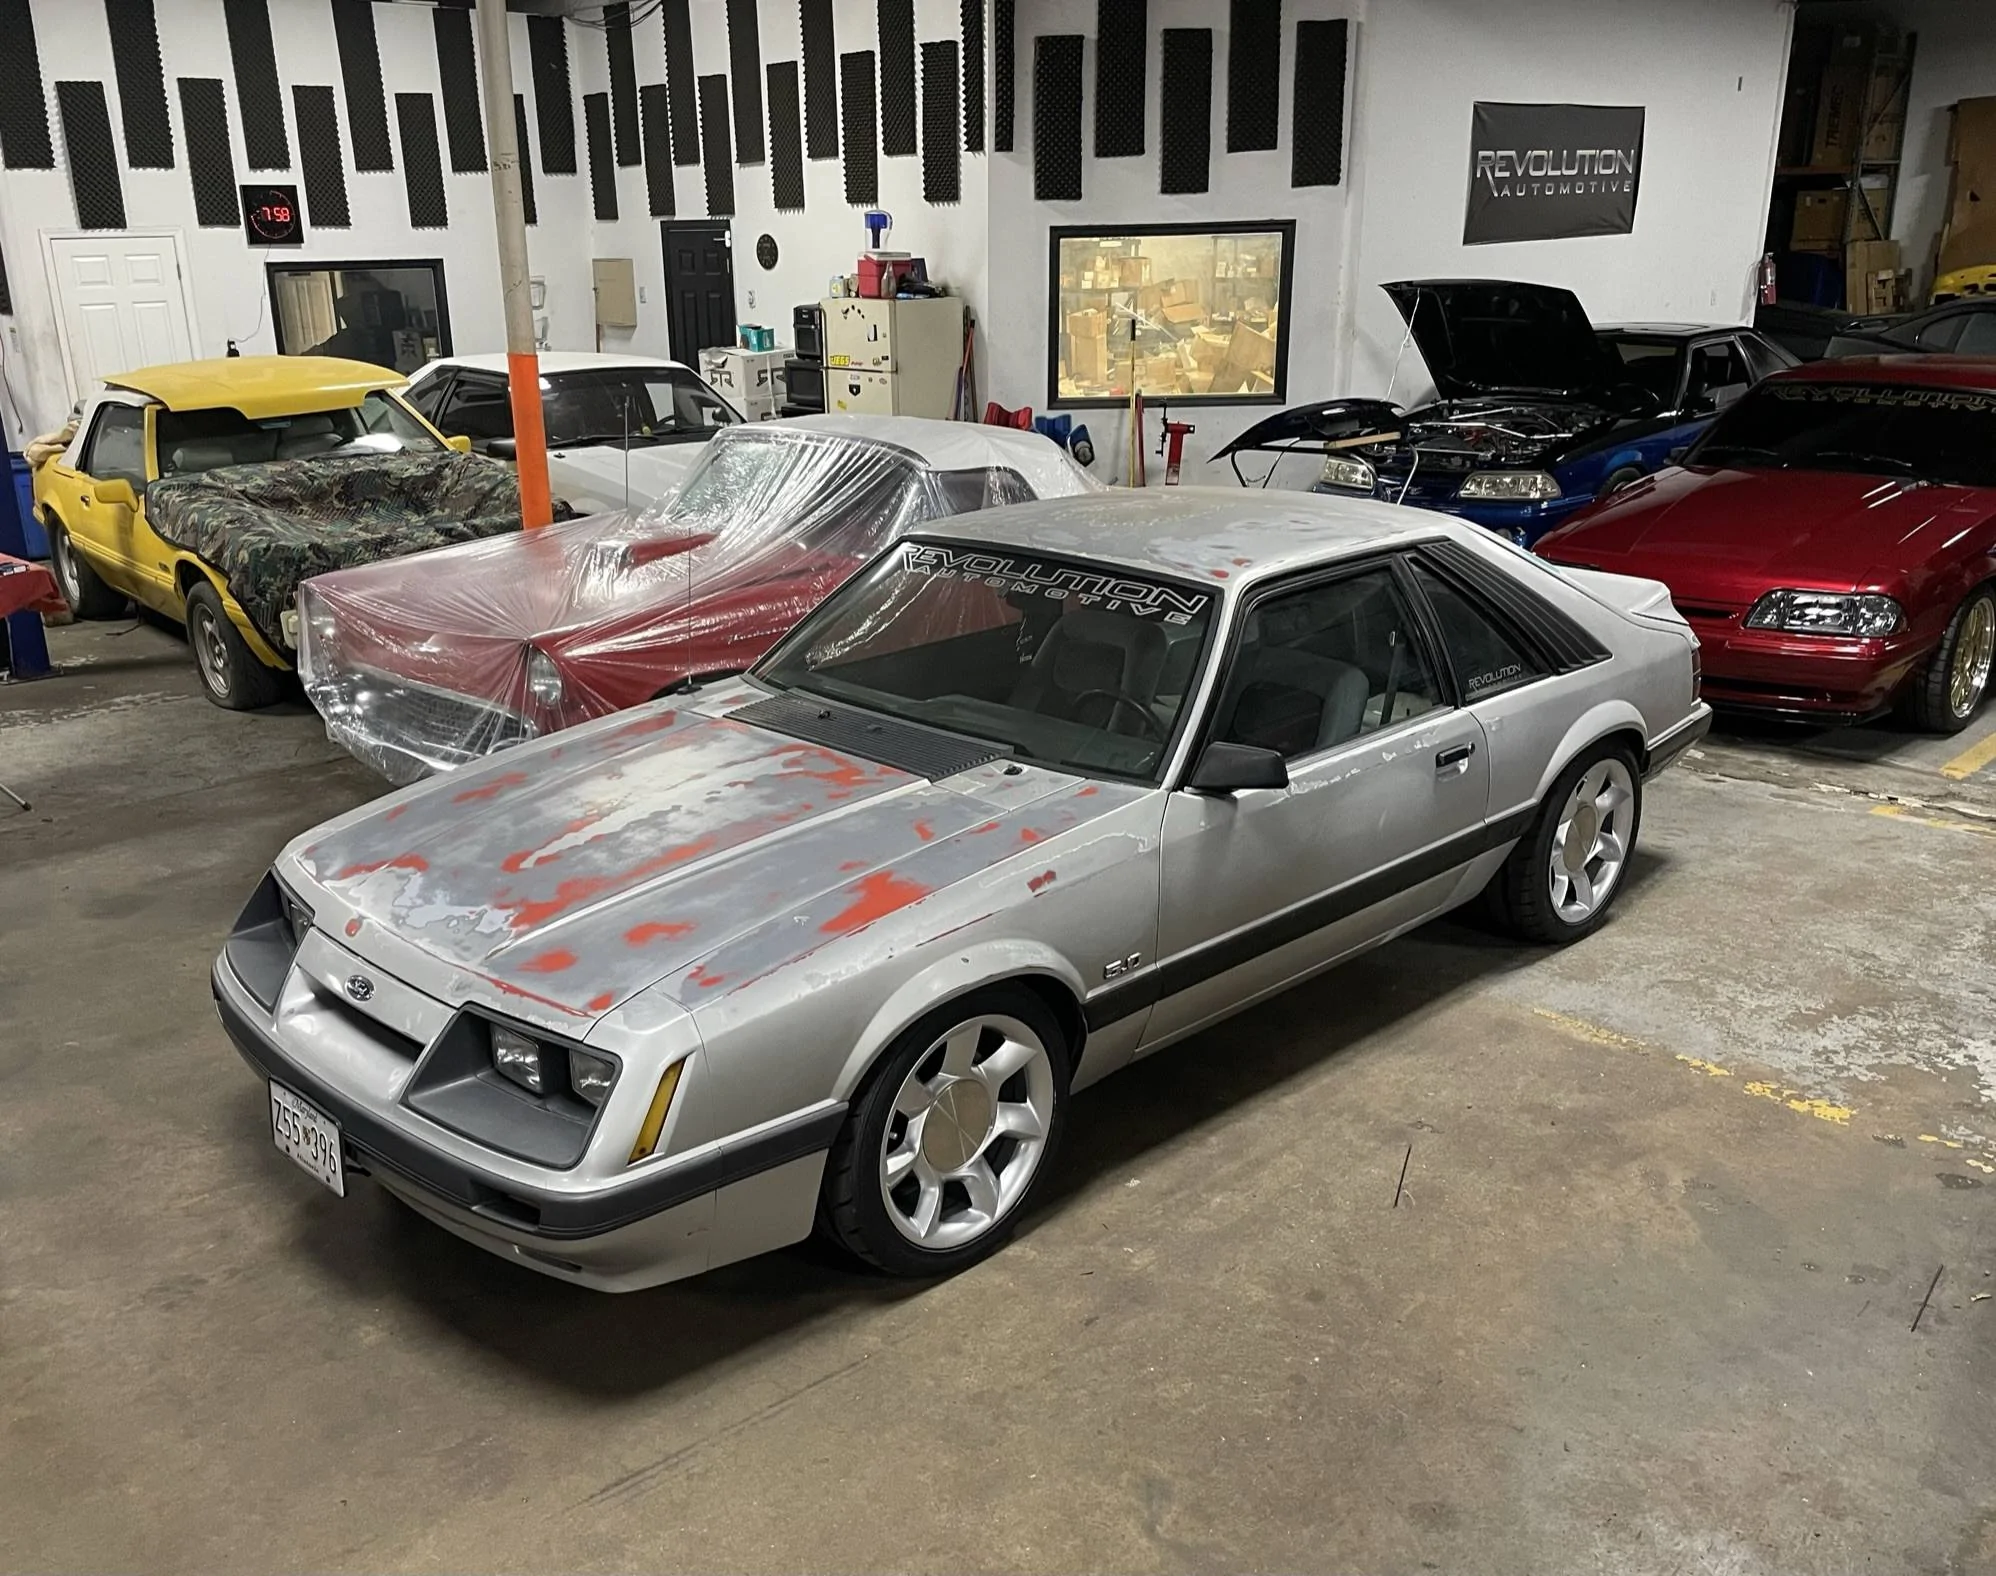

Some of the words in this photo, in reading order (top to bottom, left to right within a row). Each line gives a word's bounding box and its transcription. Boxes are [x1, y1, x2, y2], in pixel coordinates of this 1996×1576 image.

[1476, 149, 1635, 198] REVOLUTION
[1500, 180, 1632, 198] AUTOMOTIVE
[830, 355, 850, 366] JEGS
[900, 544, 1208, 615] REVOLUTION
[915, 564, 1193, 626] AUTOMOTIVE
[1469, 664, 1521, 692] REVOLUTION
[1103, 951, 1141, 980] 5.0
